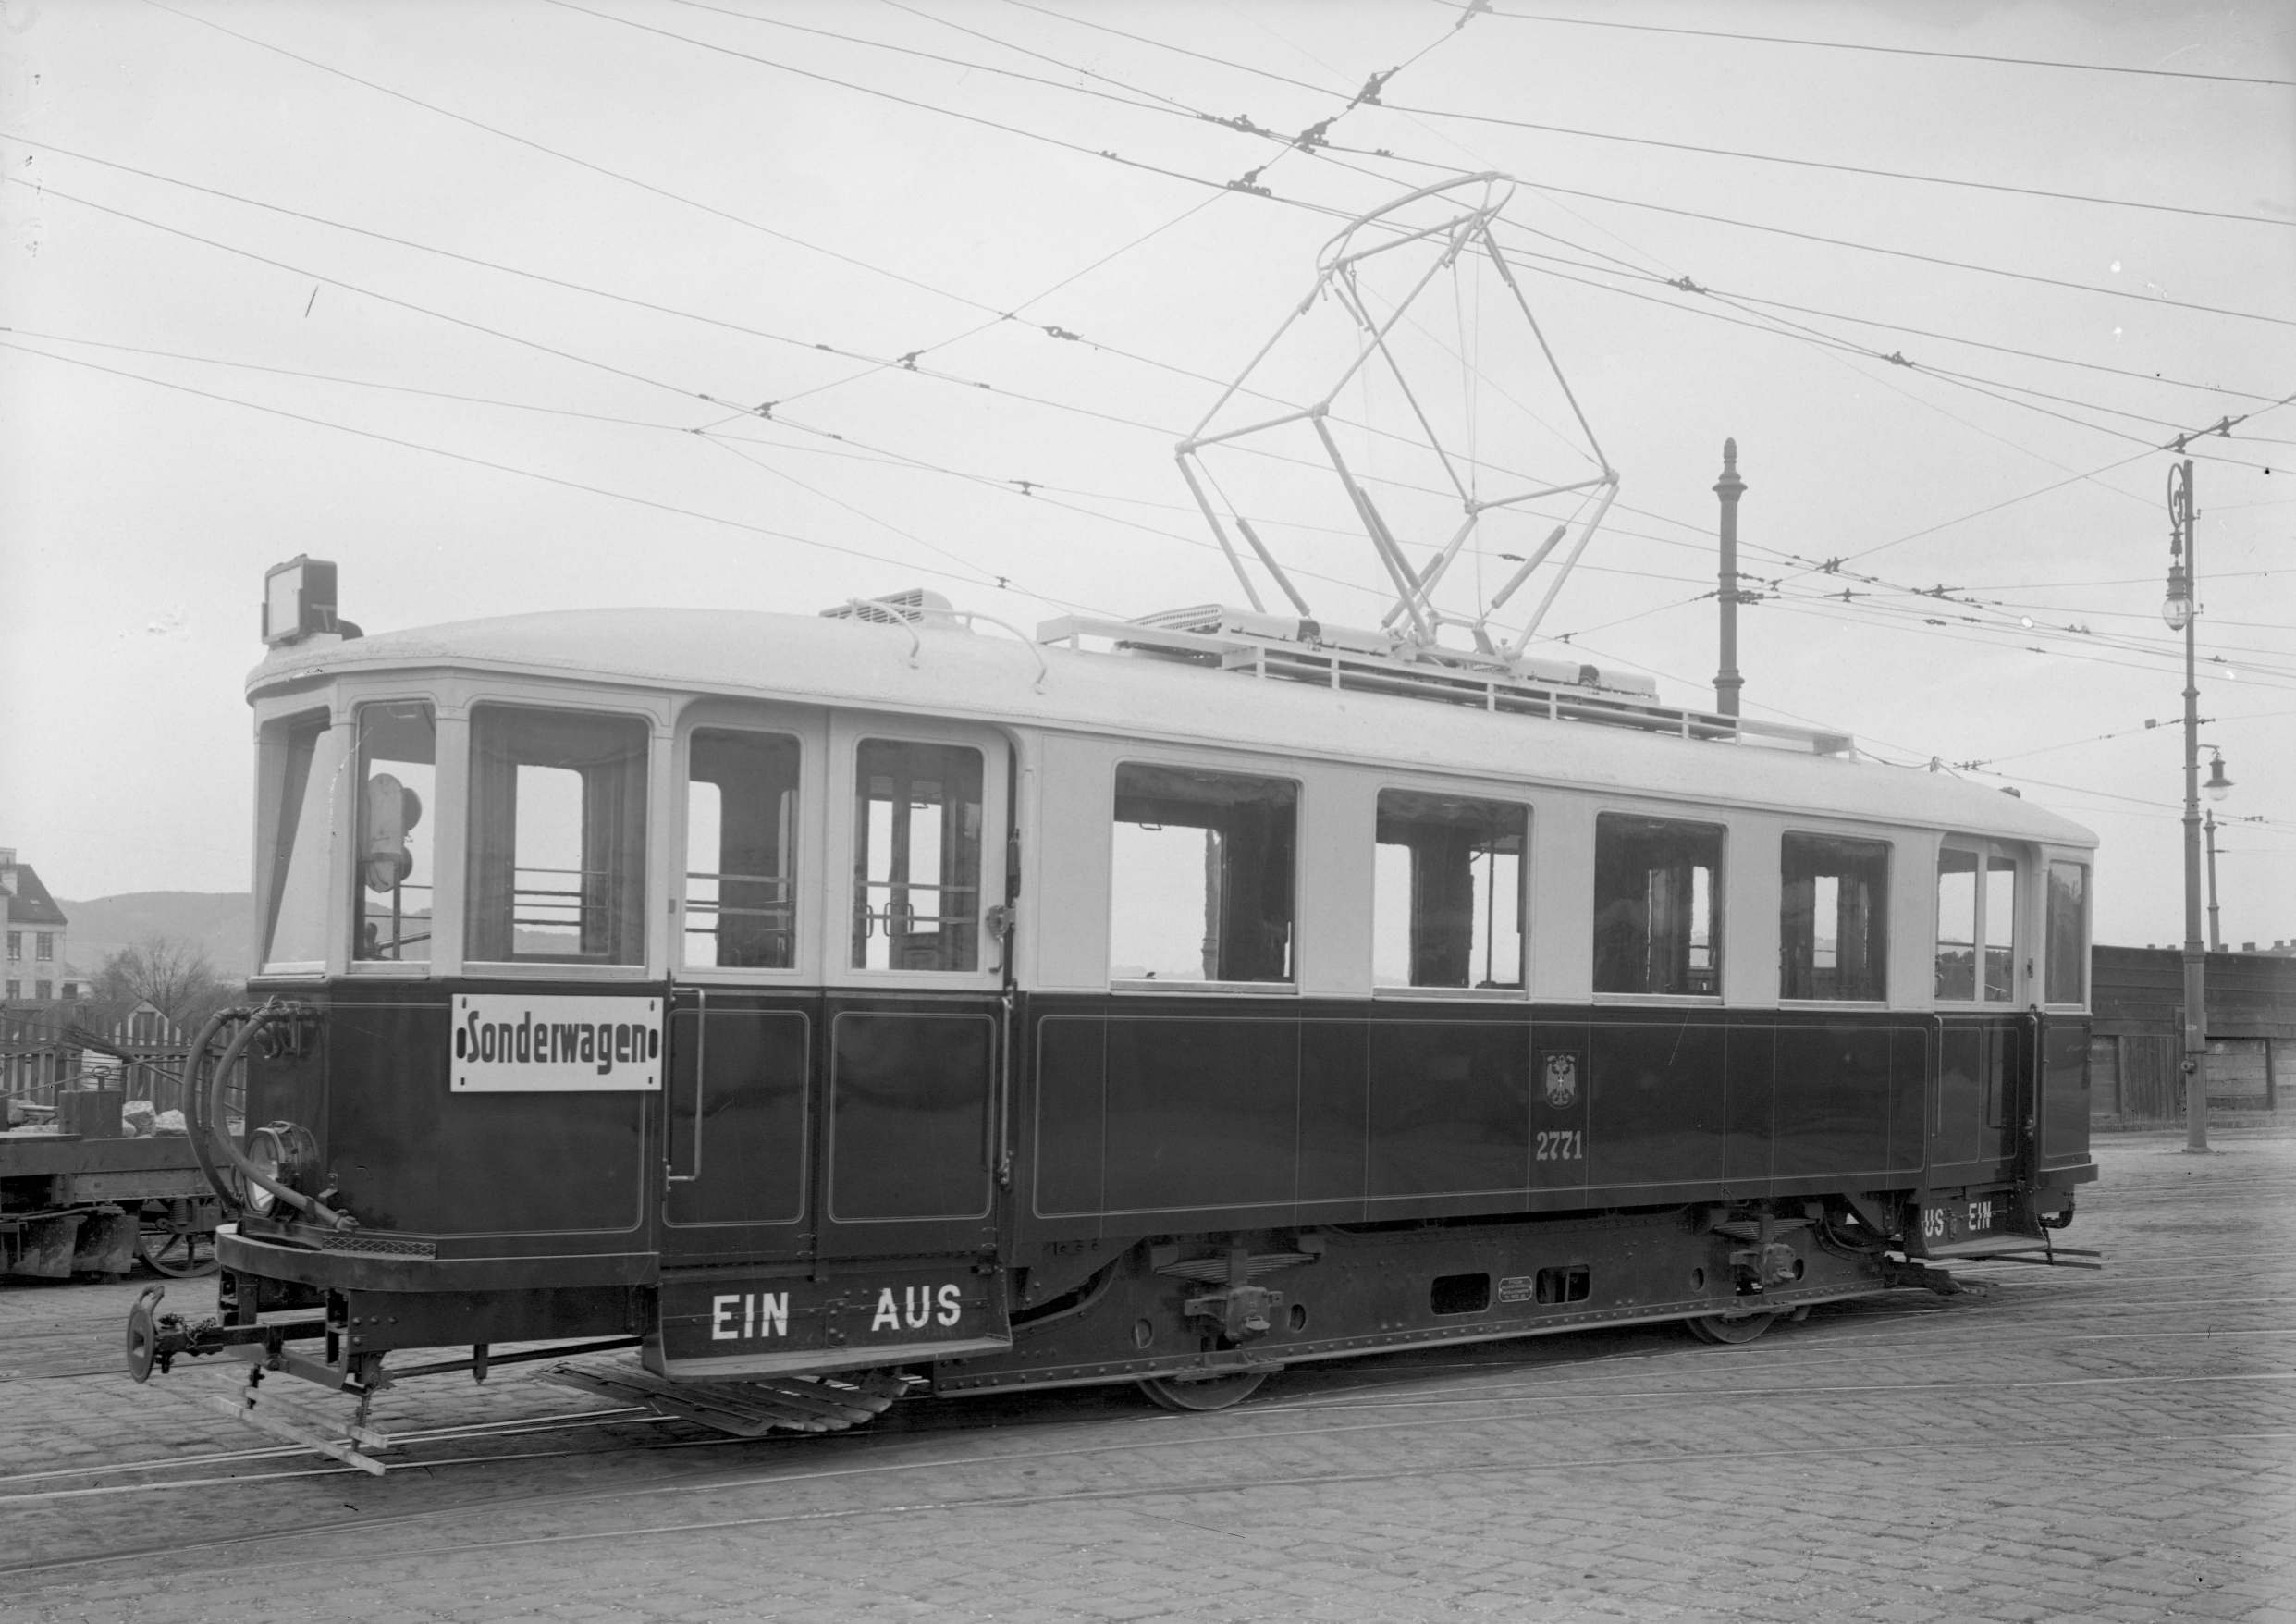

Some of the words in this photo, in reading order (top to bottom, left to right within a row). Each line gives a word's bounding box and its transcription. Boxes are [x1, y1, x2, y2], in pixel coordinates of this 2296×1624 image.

[467, 1010, 647, 1076] Sonderwagen
[1536, 1131, 1583, 1161] 2771
[1923, 1208, 1945, 1237] US
[1968, 1200, 1992, 1231] EIN
[712, 1292, 789, 1340] EIN
[871, 1284, 962, 1332] AUS
